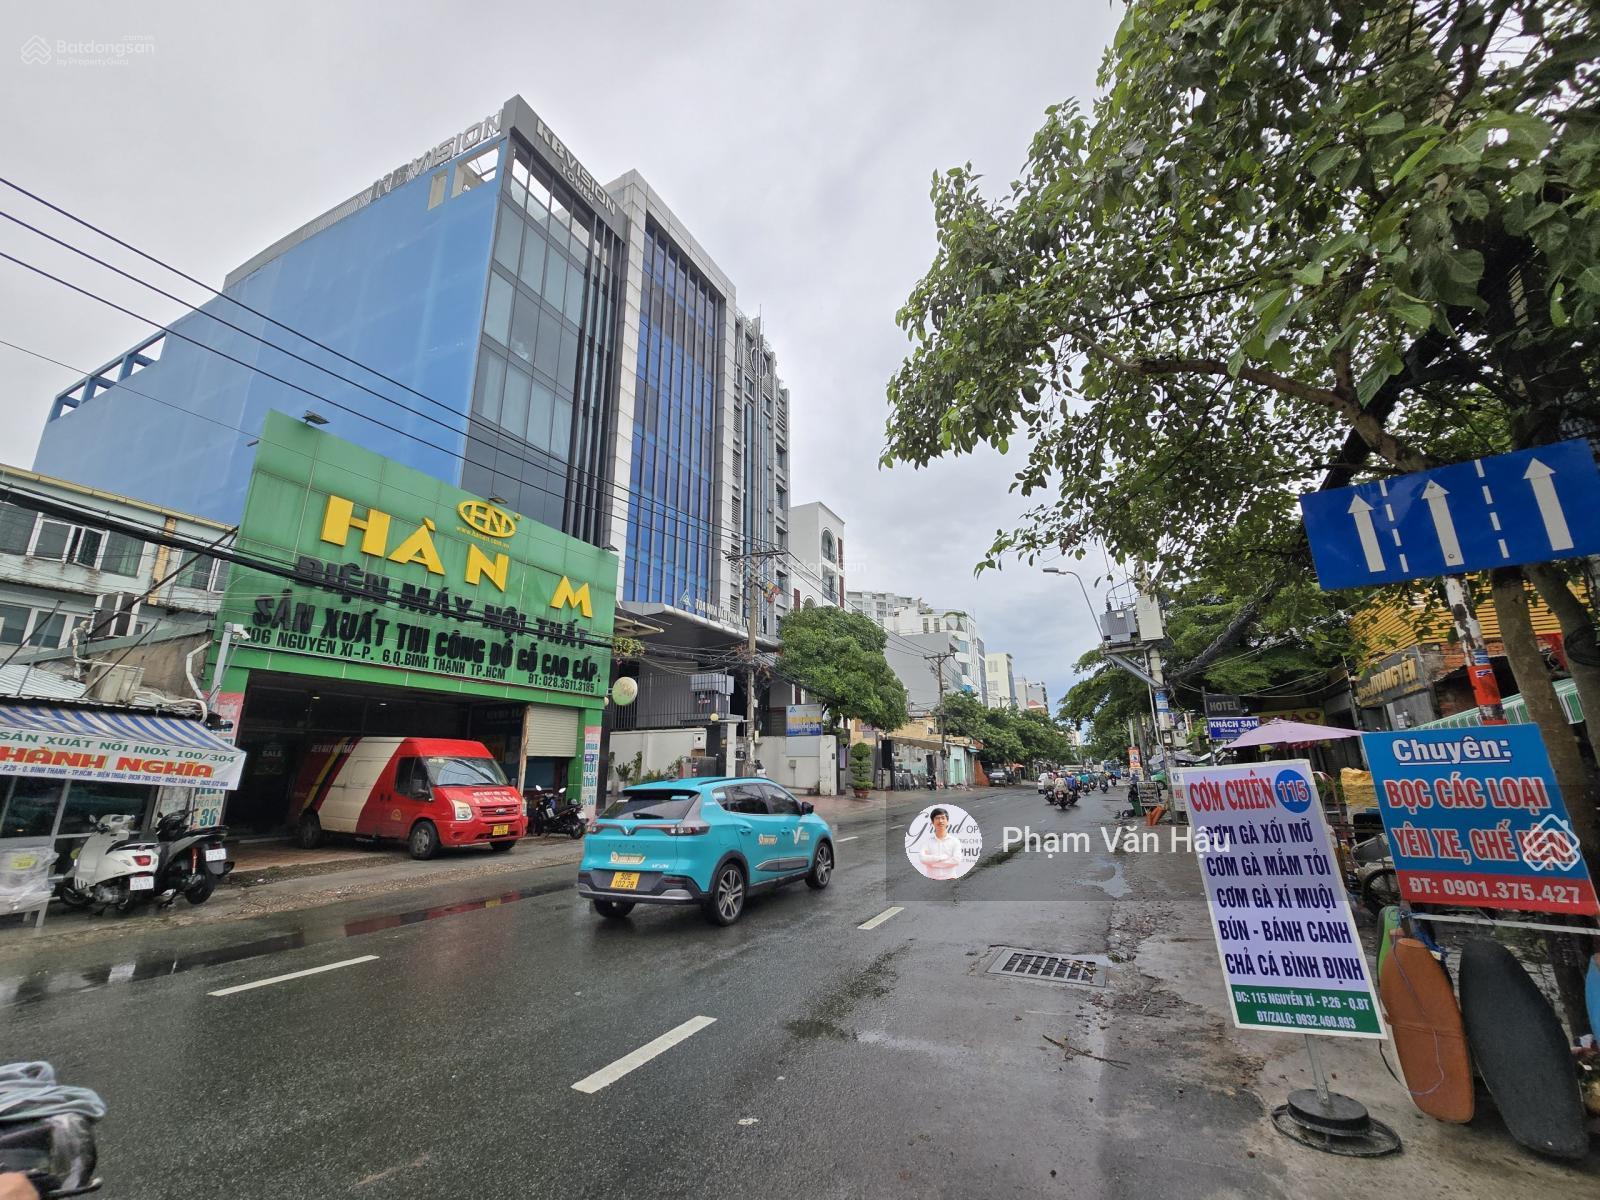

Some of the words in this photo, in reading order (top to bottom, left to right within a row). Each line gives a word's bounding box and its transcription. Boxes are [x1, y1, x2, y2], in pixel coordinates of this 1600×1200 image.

[536, 119, 616, 216] KBVISION
[561, 161, 594, 202] TOWER
[252, 588, 316, 635] SẢN
[321, 609, 390, 648] XUẤT
[396, 623, 429, 654] THI
[434, 630, 488, 662] CÔNG
[541, 653, 570, 678] CAO
[470, 664, 506, 680] TP.HCM
[1210, 701, 1238, 711] HOTEL
[1210, 719, 1239, 728] KHÁCH
[1240, 720, 1258, 729] SẠN
[0, 730, 39, 743] SẢN
[133, 745, 170, 757] INOX
[175, 750, 237, 764] 100/304
[1392, 736, 1512, 763] Chuyên:
[1189, 776, 1225, 812] CƠM
[1225, 769, 1277, 811] CHIÊN
[1278, 780, 1310, 802] 115
[1383, 778, 1433, 815] BỌC
[1434, 771, 1487, 809] CÁC
[1485, 777, 1552, 815] LOẠI
[1206, 822, 1237, 845] CƠM
[1240, 820, 1260, 845] GÀ
[1260, 816, 1287, 844] XỐI
[1288, 817, 1313, 843] MỠ
[1391, 821, 1435, 858] YÊN
[1431, 828, 1472, 865] XE,
[1469, 819, 1519, 861] GHẾ
[1206, 854, 1239, 876] CƠM
[1241, 851, 1262, 876] GÀ
[1263, 848, 1304, 876] MẮM
[1304, 847, 1331, 875] TỎI
[1217, 887, 1250, 908] CƠM
[1251, 884, 1274, 908] GÀ
[1274, 883, 1293, 909] XÍ
[1294, 883, 1337, 914] MUỘI
[1409, 876, 1440, 894] ĐT:
[1443, 878, 1580, 904] 0901.375.427
[1218, 916, 1250, 940] BÚN
[1261, 916, 1305, 943] BÁNH
[1306, 921, 1352, 943] CANH
[1224, 946, 1256, 975] CHẢ
[1258, 950, 1280, 977] CÁ
[1280, 951, 1320, 978] BÌNH
[1321, 957, 1365, 984] ĐỊNH
[1251, 992, 1268, 1003] 115
[1268, 990, 1302, 1006] NGUYỄN
[1303, 993, 1315, 1007] XÍ
[1321, 997, 1341, 1009] P.26
[1257, 1010, 1294, 1025] ĐT/ZALO:
[1296, 1013, 1356, 1029] 0932.460.893
